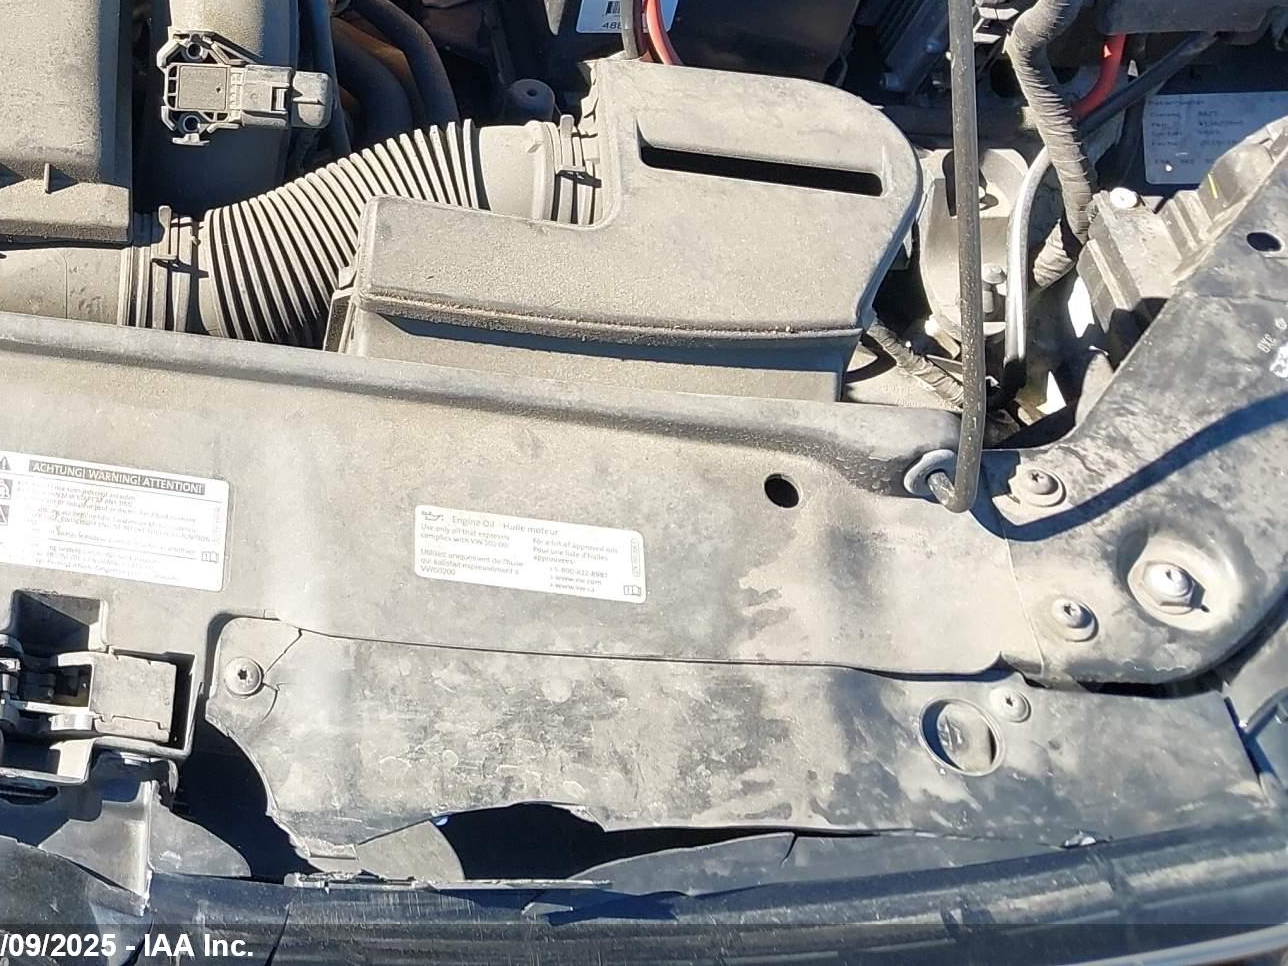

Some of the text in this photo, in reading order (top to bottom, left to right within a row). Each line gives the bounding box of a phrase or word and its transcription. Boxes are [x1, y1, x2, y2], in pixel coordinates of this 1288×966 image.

[32, 461, 86, 480] ACHTUNG!
[88, 469, 141, 487] WARNING!
[142, 476, 203, 494] ATTENTION!
[452, 515, 559, 536] Engine Oil Huile moteur
